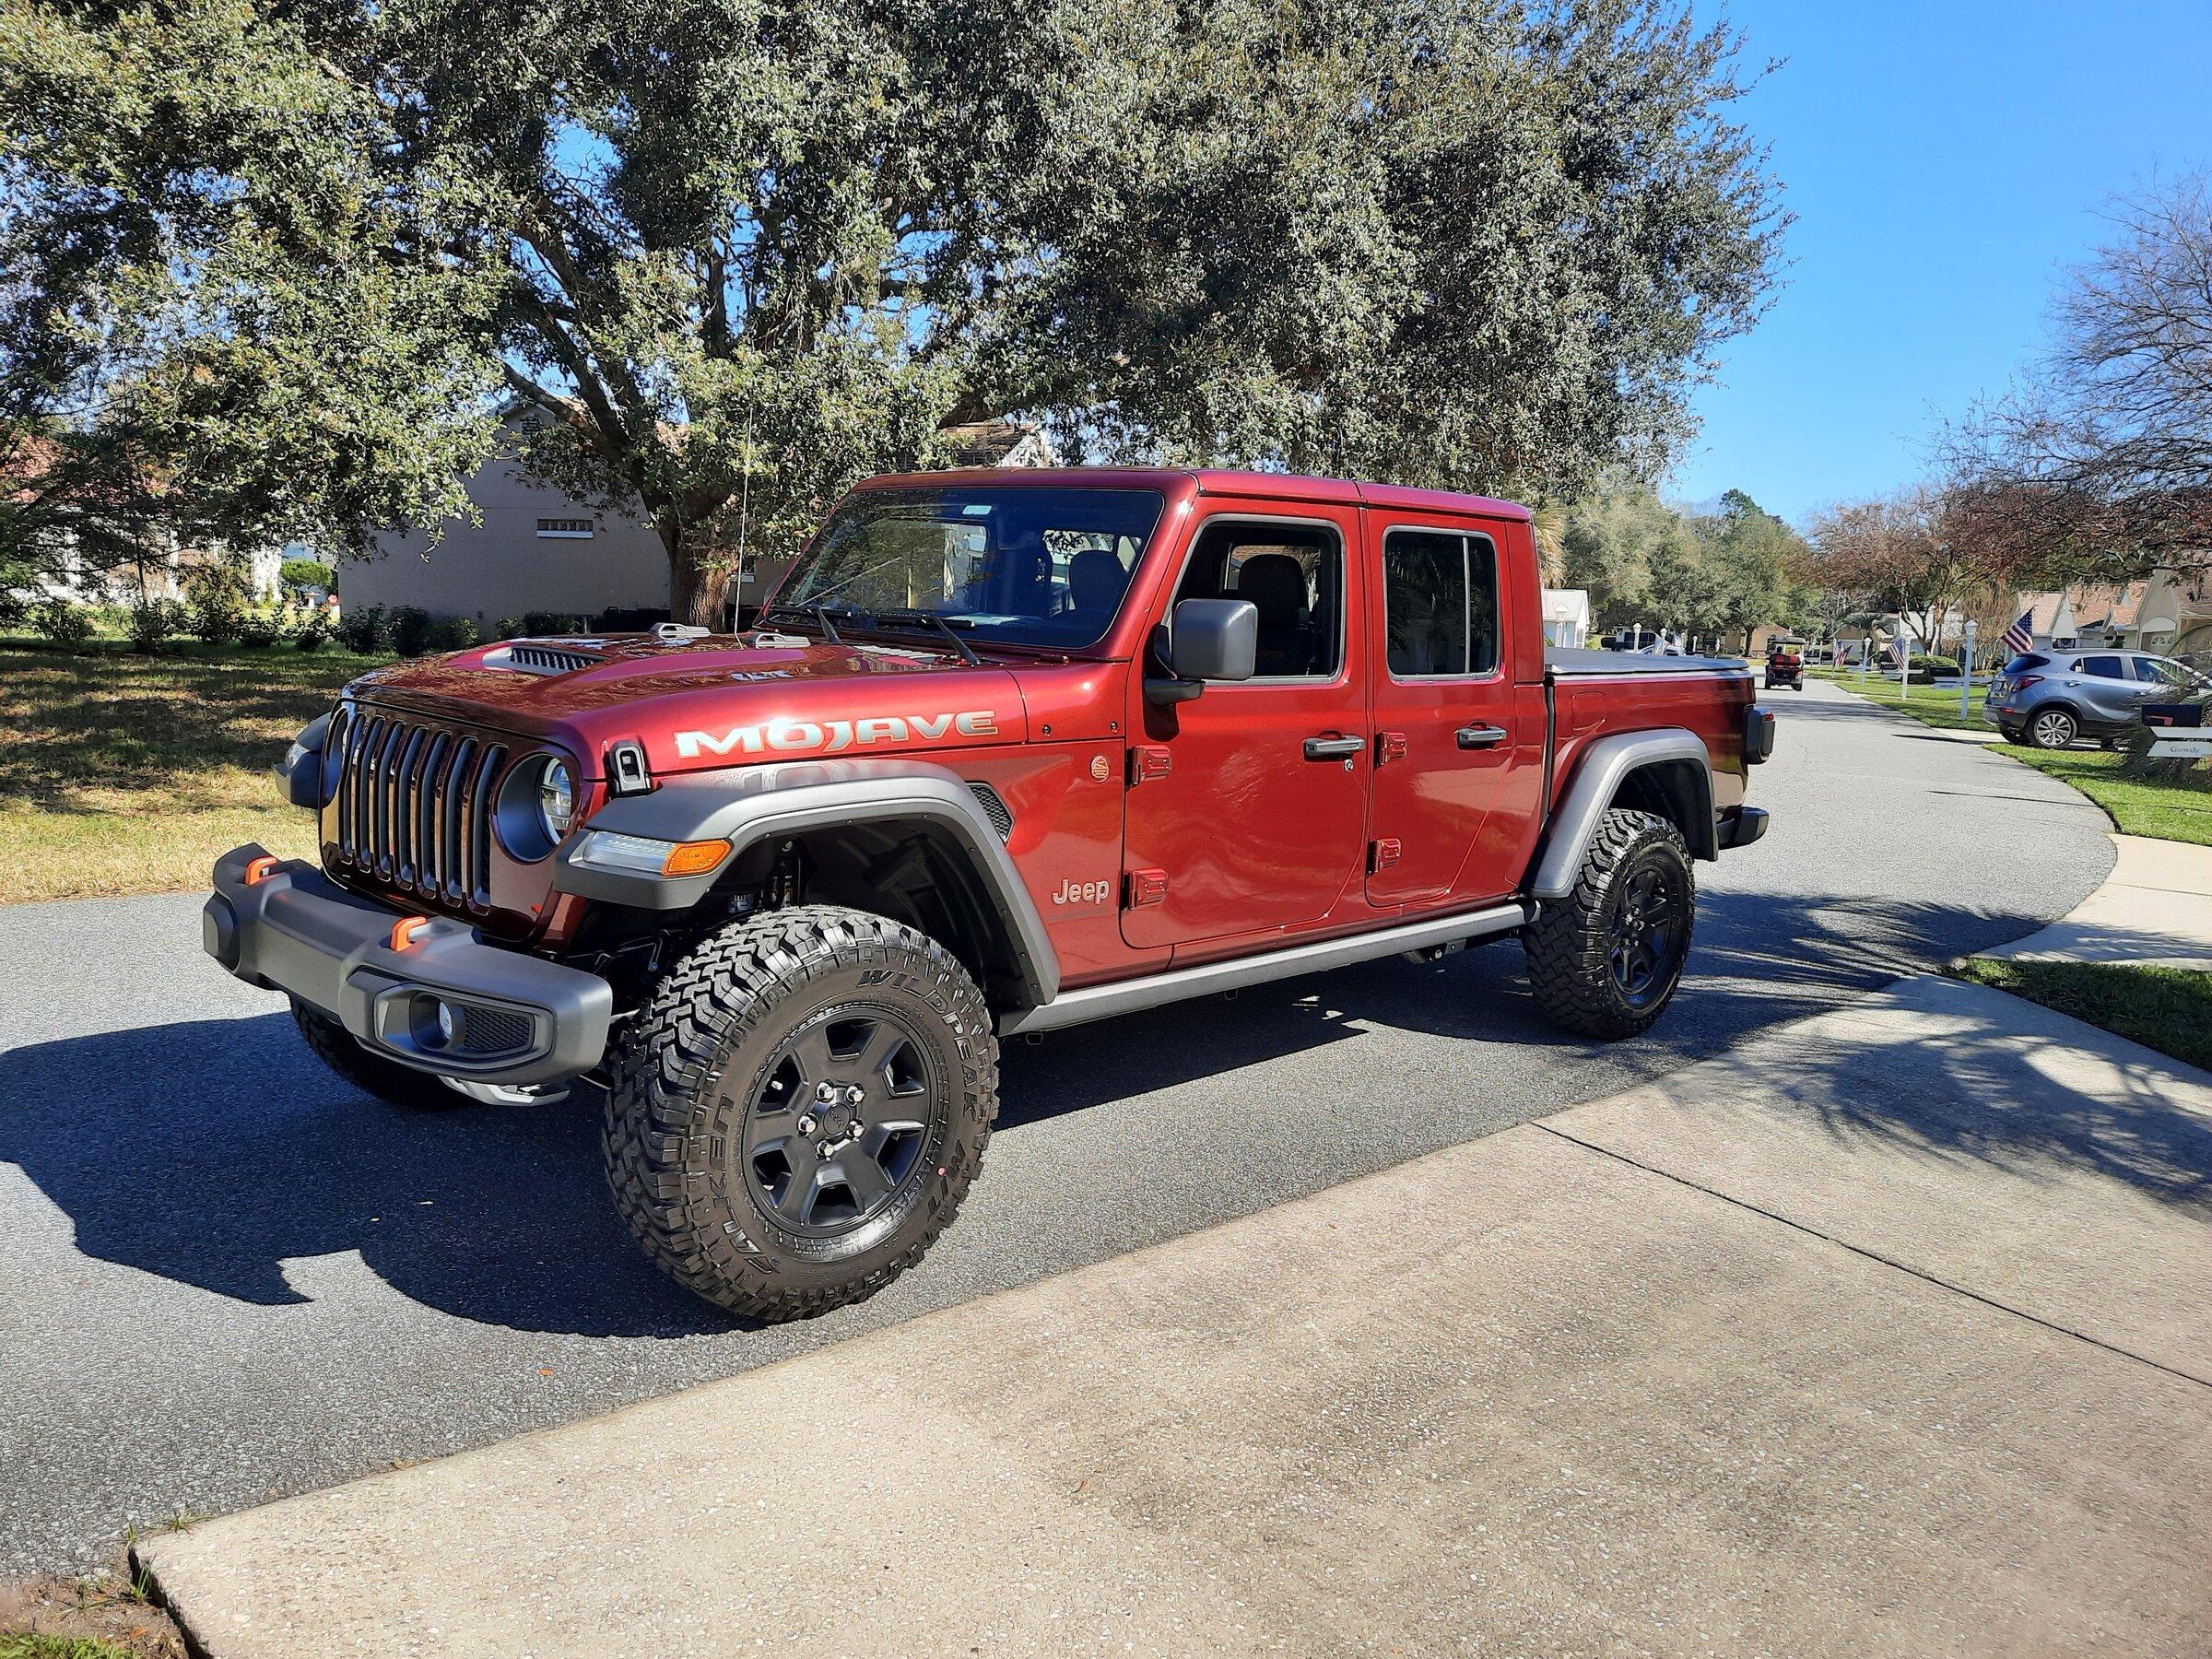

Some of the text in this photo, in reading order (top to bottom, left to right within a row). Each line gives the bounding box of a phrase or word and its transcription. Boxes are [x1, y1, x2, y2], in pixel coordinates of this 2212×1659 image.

[674, 711, 998, 759] MOJAVE
[1052, 878, 1110, 905] Jeep
[856, 968, 979, 1124] WILDPEAK
